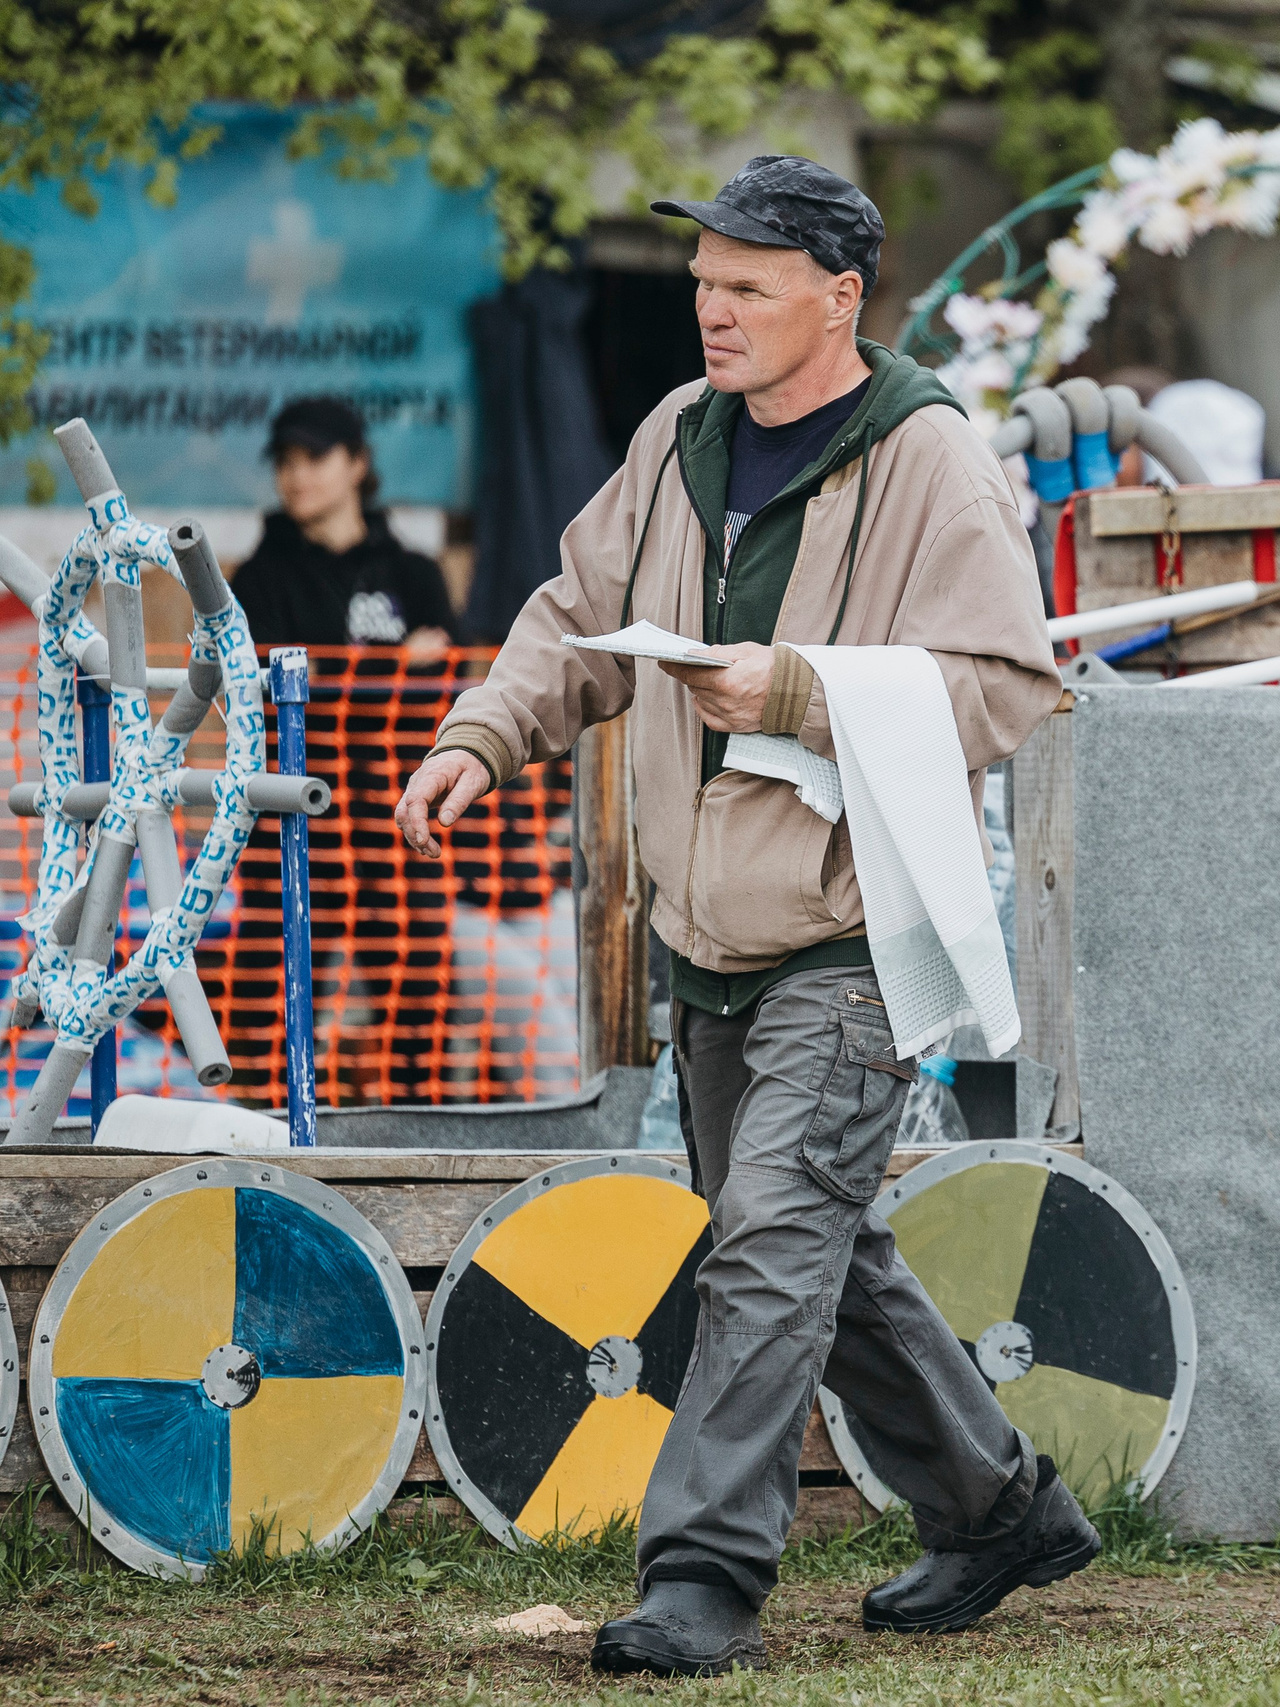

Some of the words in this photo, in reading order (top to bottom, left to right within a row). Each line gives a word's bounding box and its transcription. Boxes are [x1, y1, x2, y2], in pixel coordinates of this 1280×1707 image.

[40, 317, 136, 366] ЕНТР
[145, 308, 423, 367] ВЕТЕРИНАРНОЙ
[24, 384, 270, 432] АБИЛИТАЦИИ
